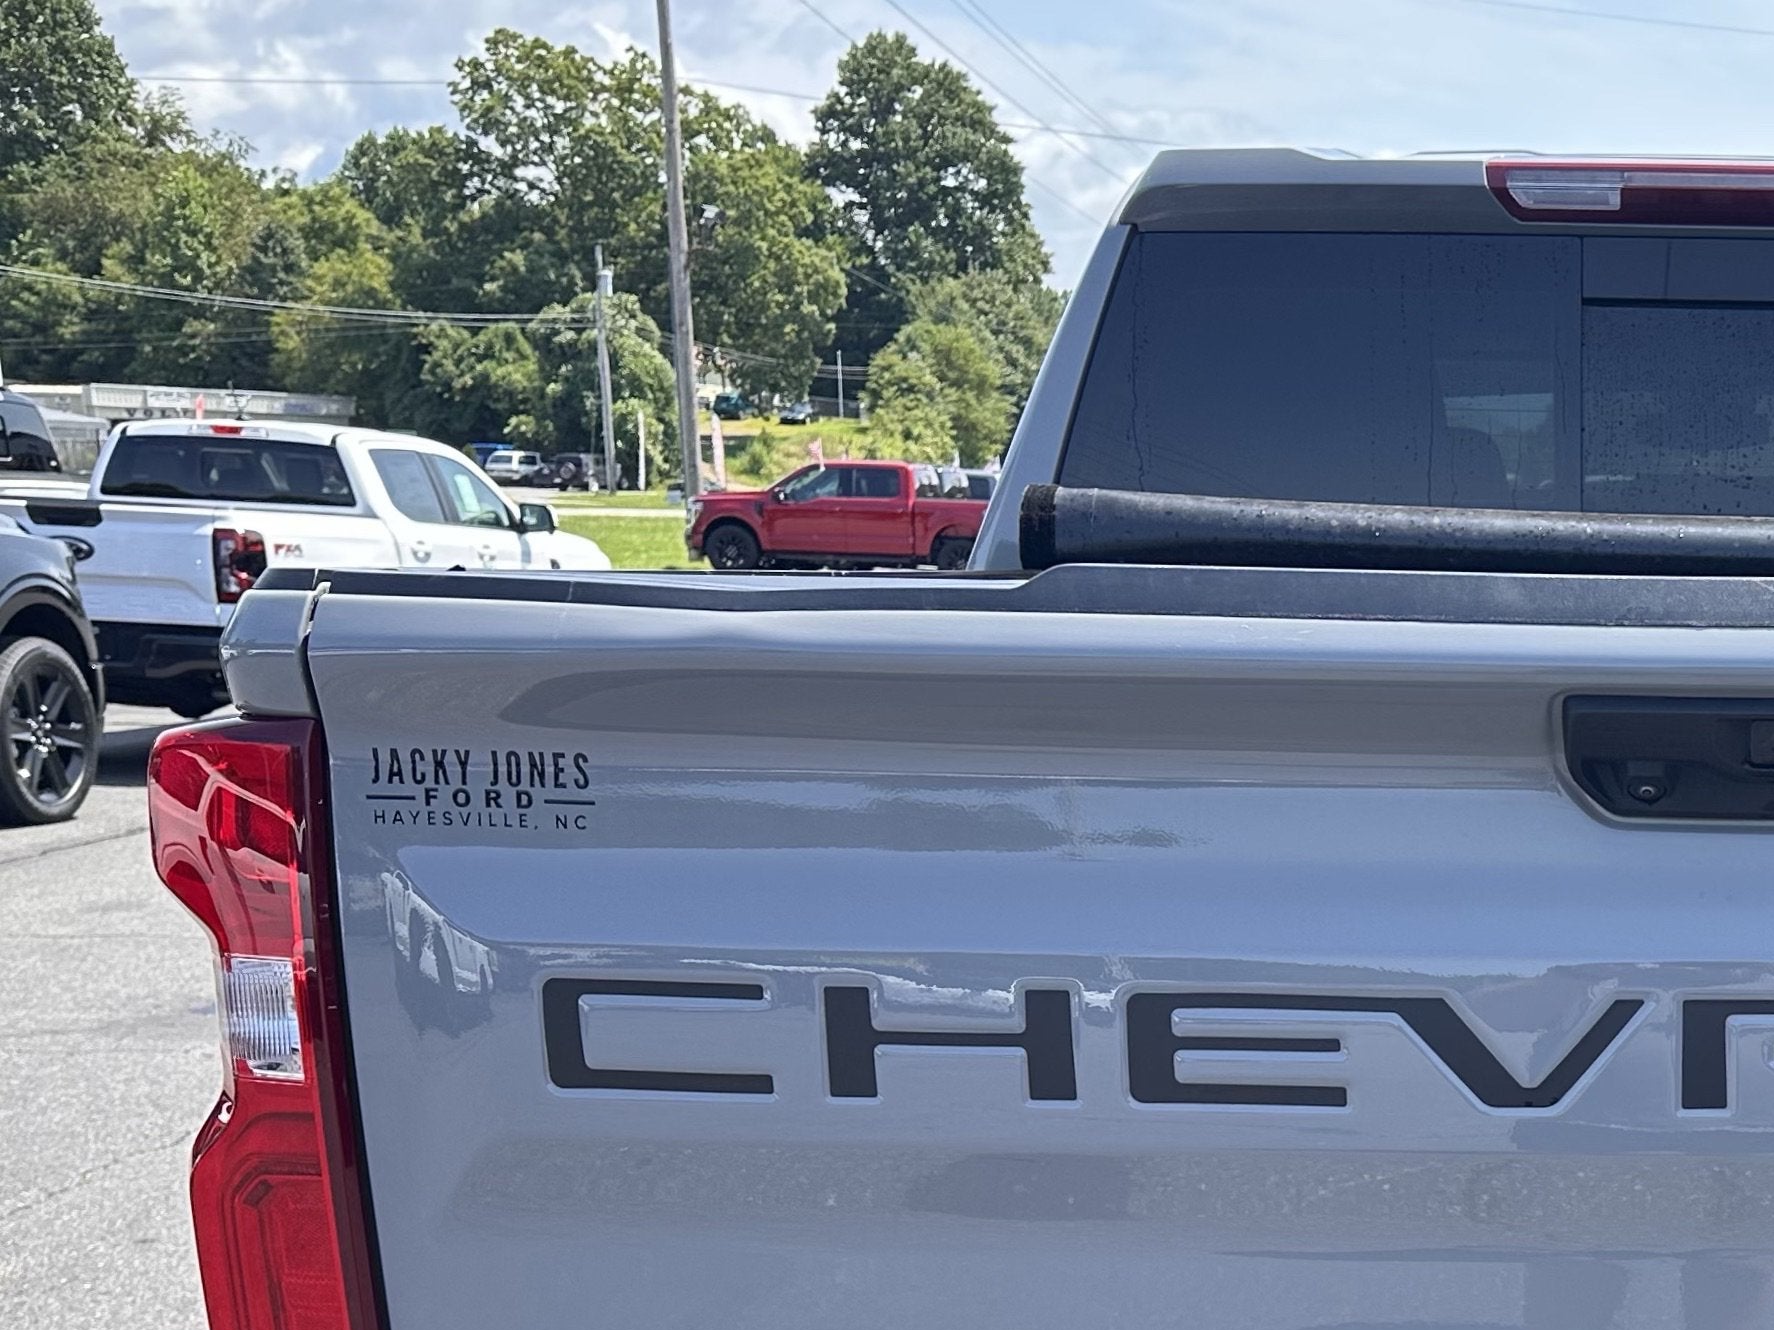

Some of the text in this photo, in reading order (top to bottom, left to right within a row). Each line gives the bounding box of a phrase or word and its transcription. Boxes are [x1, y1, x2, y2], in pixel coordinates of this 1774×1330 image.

[371, 747, 590, 790] JACKY JONES
[424, 787, 534, 809] FORD
[373, 809, 588, 830] HAYESVILLE, NC
